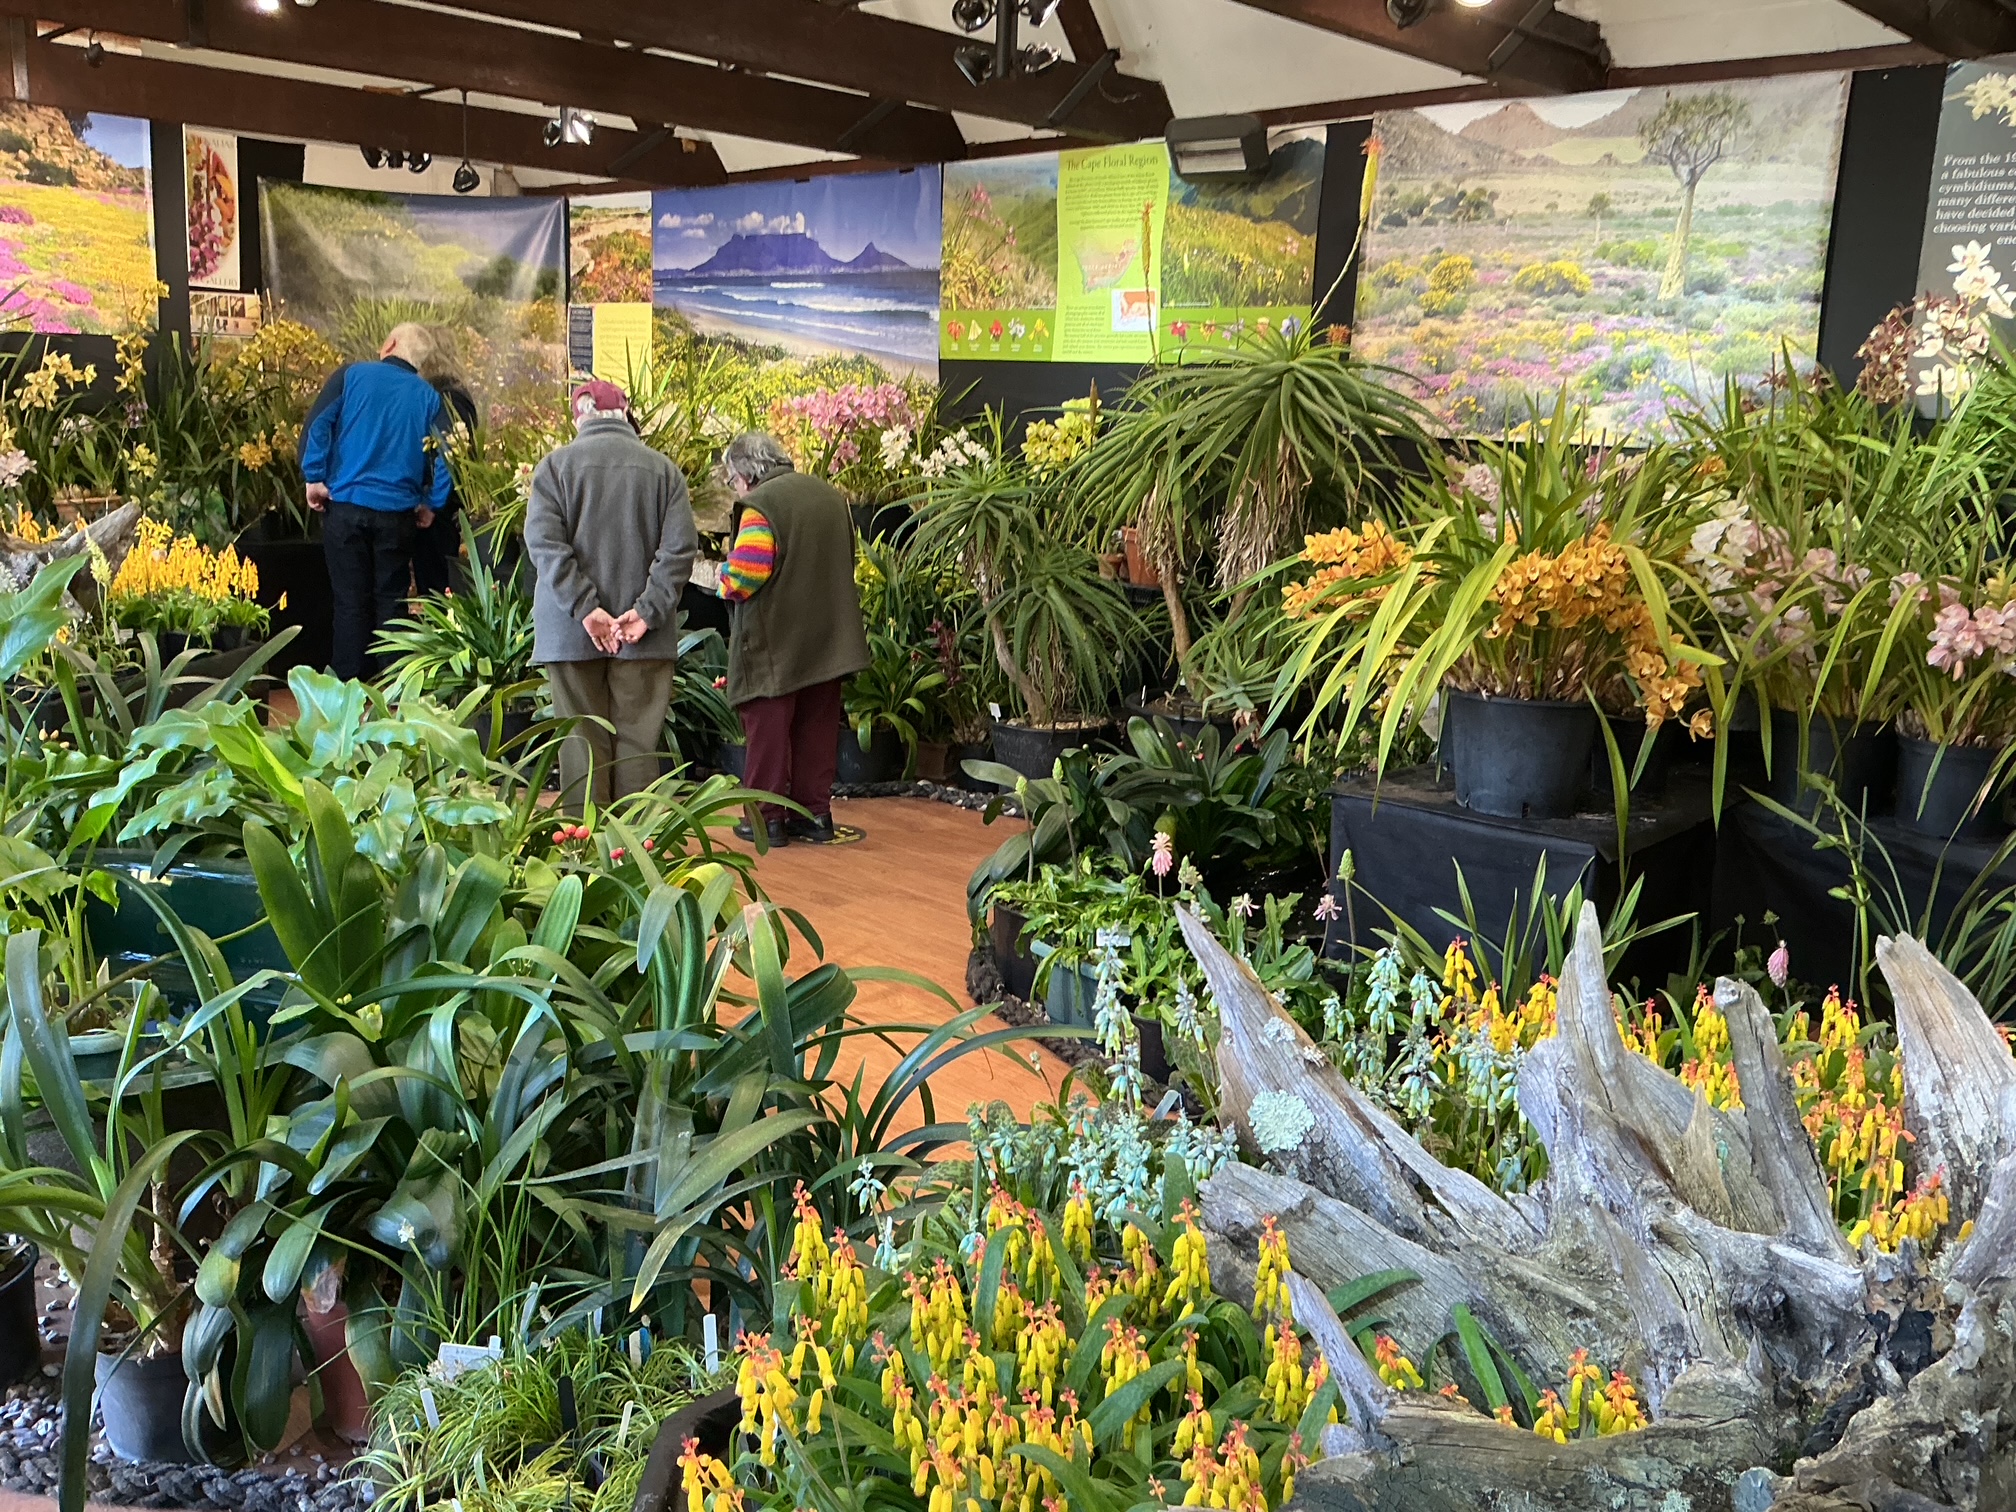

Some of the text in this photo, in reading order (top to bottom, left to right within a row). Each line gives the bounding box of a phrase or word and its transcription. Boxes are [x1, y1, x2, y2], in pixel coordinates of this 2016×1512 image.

[1081, 157, 1101, 173] Cape
[1103, 154, 1127, 168] Floral
[1943, 153, 1977, 167] From
[1980, 151, 2001, 165] the
[1940, 170, 1949, 180] a
[1951, 166, 2006, 180] fabulous
[1937, 193, 2016, 208] many differe
[1935, 205, 2016, 220] have decided
[1933, 221, 1987, 234] choosing
